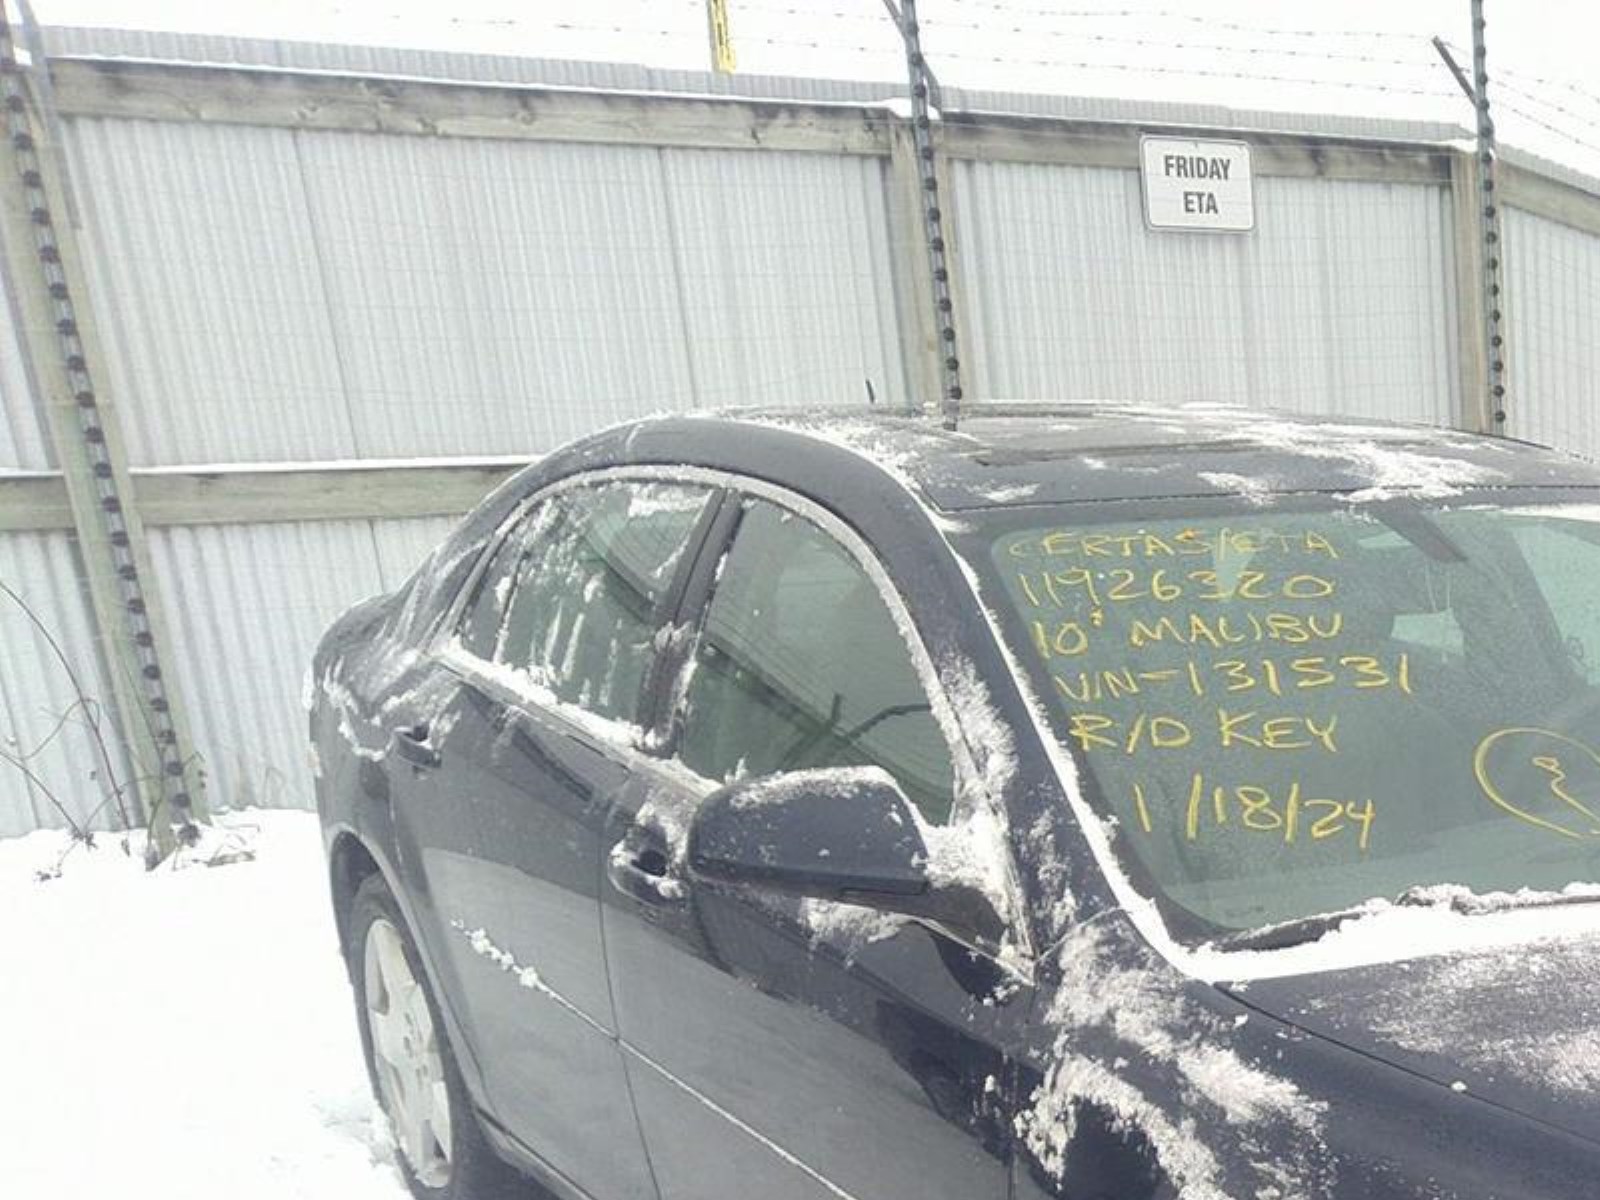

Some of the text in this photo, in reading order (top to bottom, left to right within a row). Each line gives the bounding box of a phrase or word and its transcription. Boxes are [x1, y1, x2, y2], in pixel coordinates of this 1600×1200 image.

[1164, 155, 1231, 180] FRIDAY
[1184, 191, 1218, 214] ETA
[1018, 566, 1335, 607] 11926320
[1130, 613, 1343, 648] MALIBU
[1217, 709, 1339, 752] KEY
